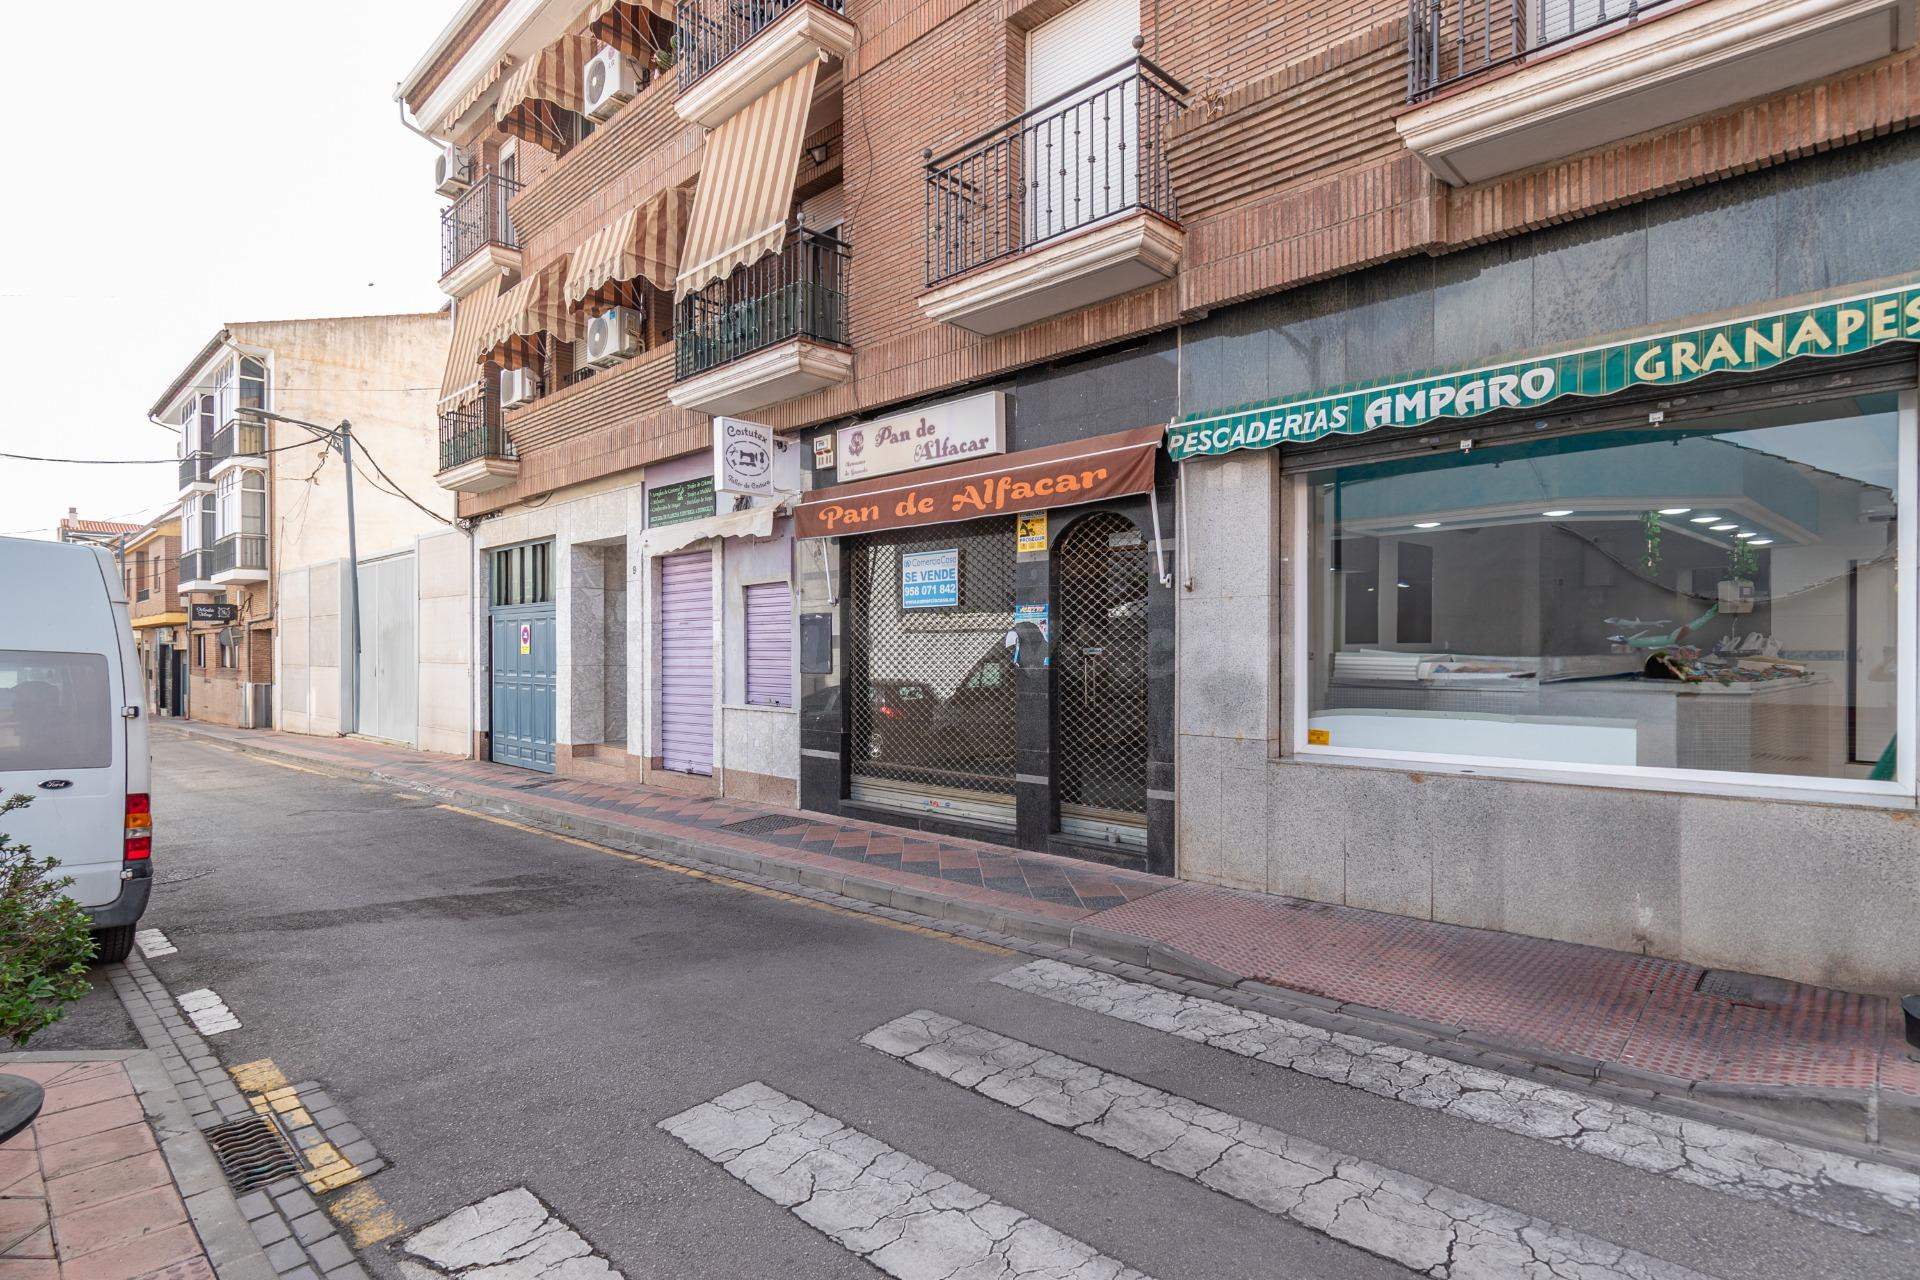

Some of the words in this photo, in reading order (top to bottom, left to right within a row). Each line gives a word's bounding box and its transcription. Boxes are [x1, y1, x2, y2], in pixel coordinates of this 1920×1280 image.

[1168, 405, 1349, 453] PESCADERIAS
[1365, 367, 1555, 430] AMPARO
[727, 425, 768, 444] Costutex
[874, 425, 911, 448] Pan
[916, 417, 936, 438] de
[914, 436, 989, 462] Alfacar
[818, 504, 879, 529] Pan
[895, 492, 934, 517] de
[952, 468, 1107, 511] Alfacar
[905, 571, 917, 582] SE
[920, 568, 956, 581] VENDE
[904, 586, 920, 597] 958
[921, 584, 937, 596] 071
[939, 583, 956, 595] 842
